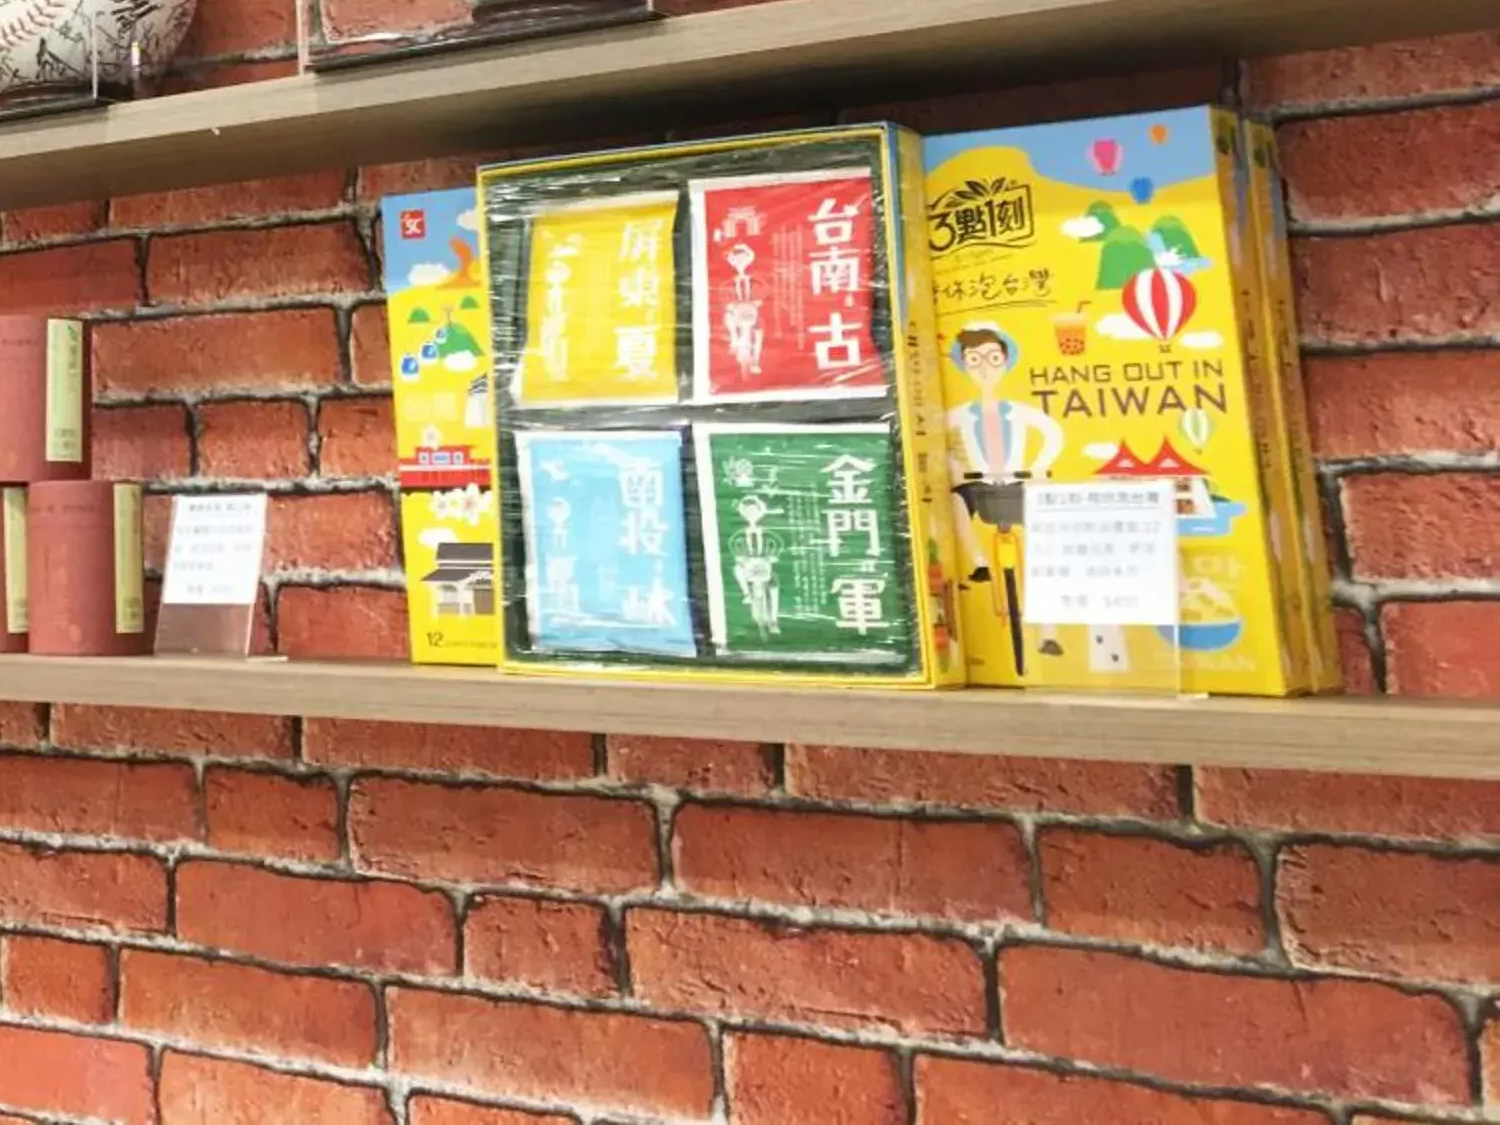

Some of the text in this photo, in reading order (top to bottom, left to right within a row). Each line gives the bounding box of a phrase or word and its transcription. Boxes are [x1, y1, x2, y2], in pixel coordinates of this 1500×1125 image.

[1029, 359, 1223, 385] HANG OUT IN
[1031, 383, 1227, 418] TAIWAN
